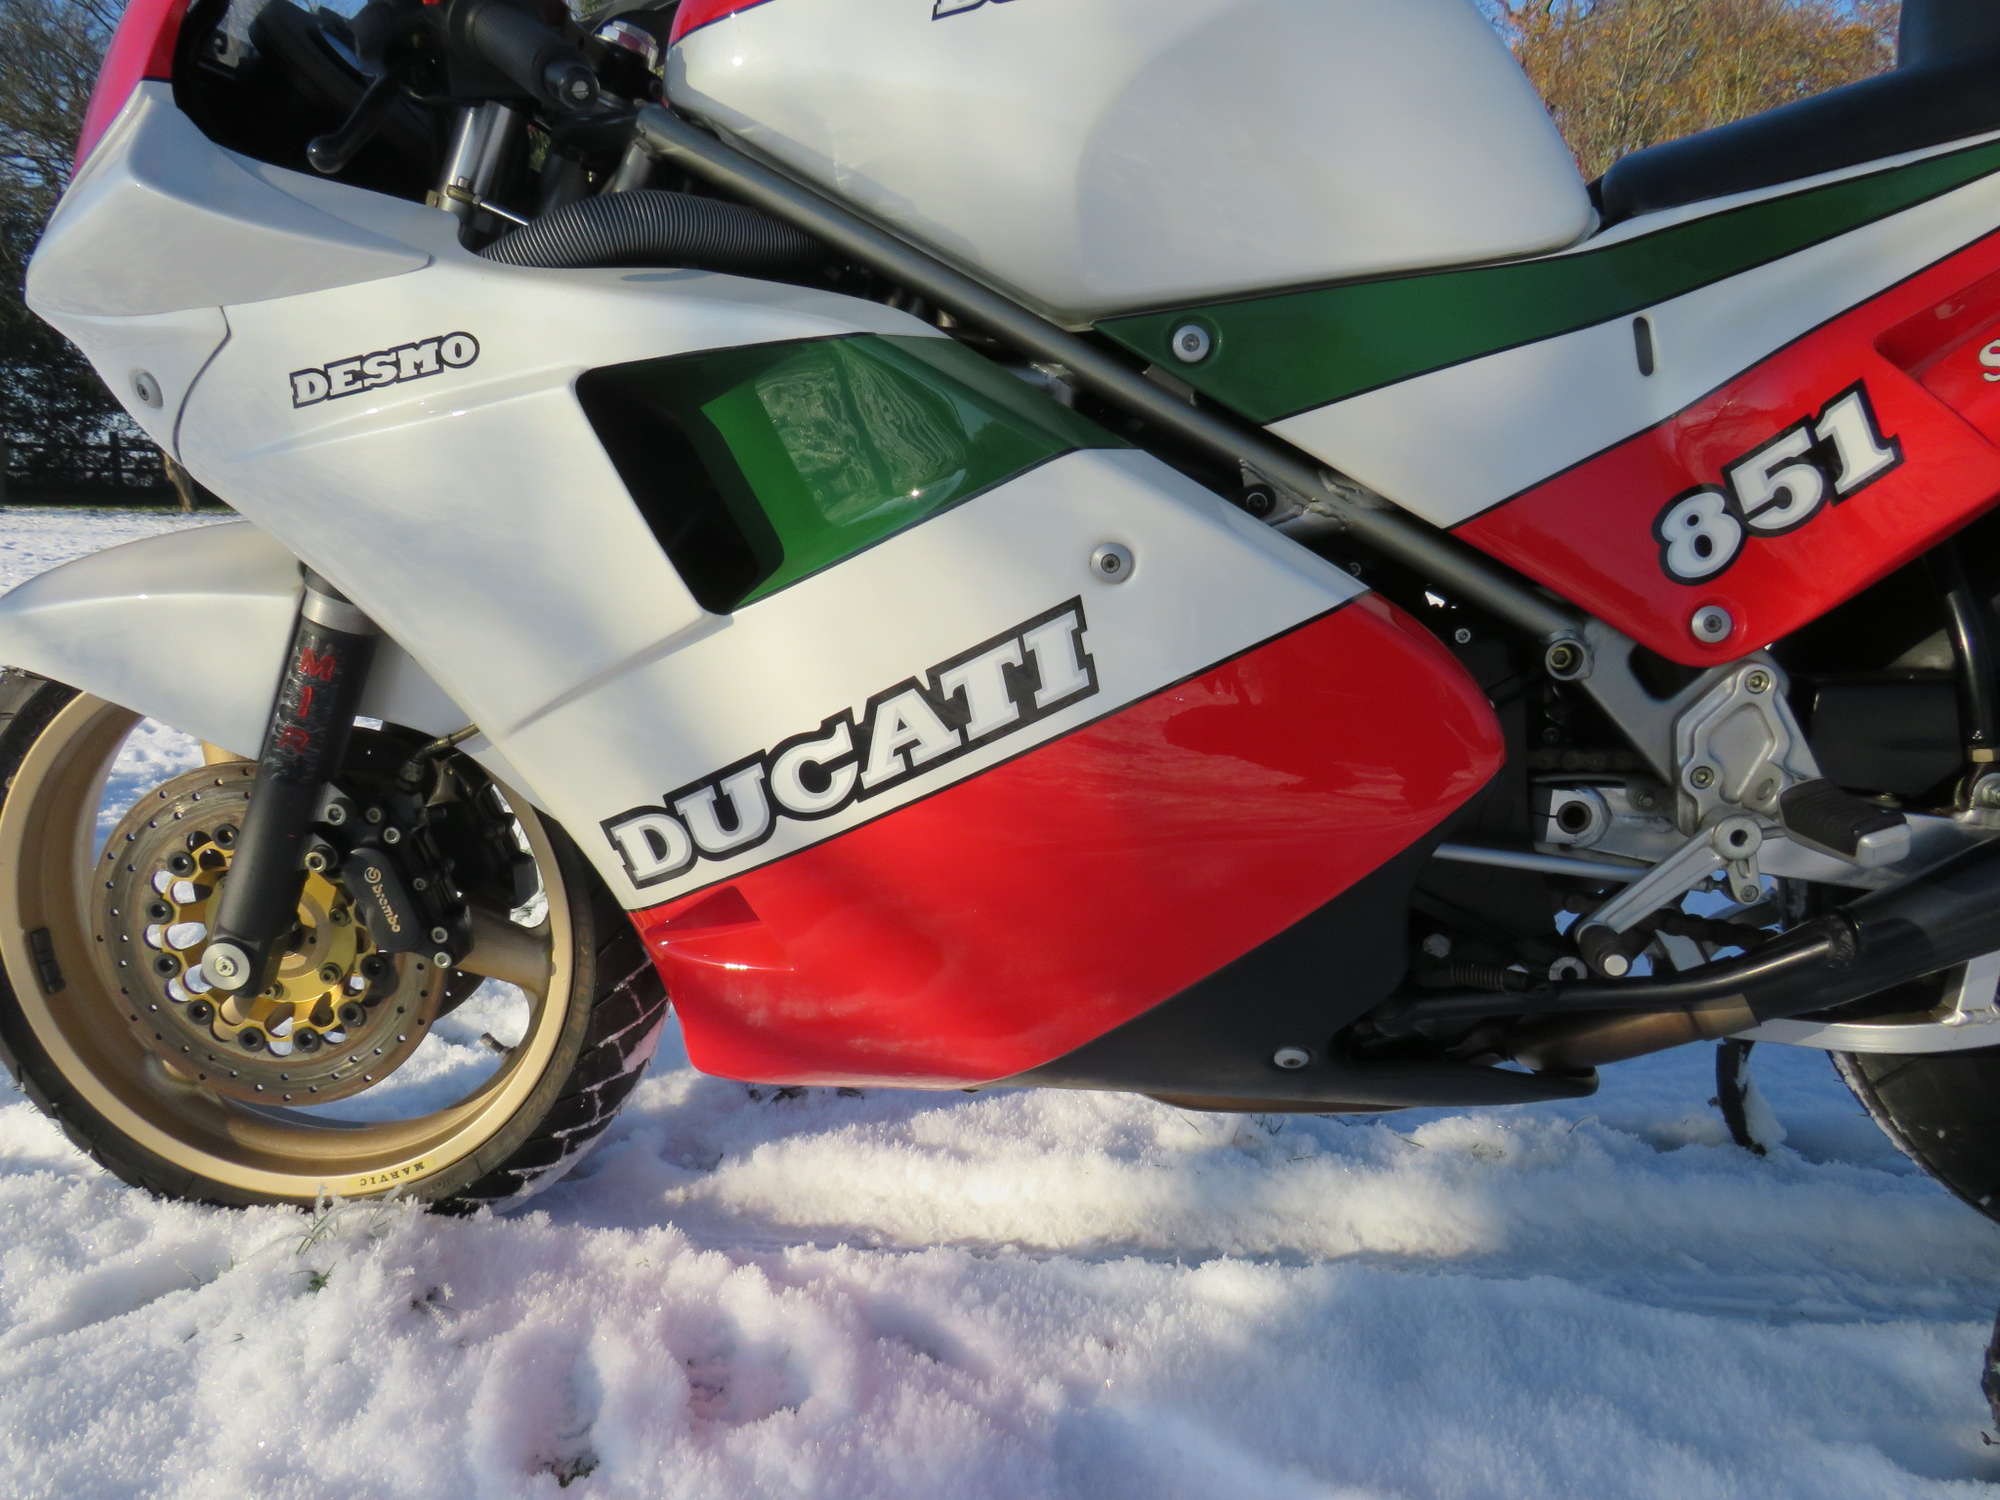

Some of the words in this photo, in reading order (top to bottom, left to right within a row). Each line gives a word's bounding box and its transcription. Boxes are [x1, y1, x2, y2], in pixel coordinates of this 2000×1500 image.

[289, 331, 481, 409] DESMO
[1652, 378, 1905, 586] 851
[600, 594, 1100, 890] DUCATI
[371, 883, 401, 933] brembo
[359, 1161, 425, 1186] MARVIC
